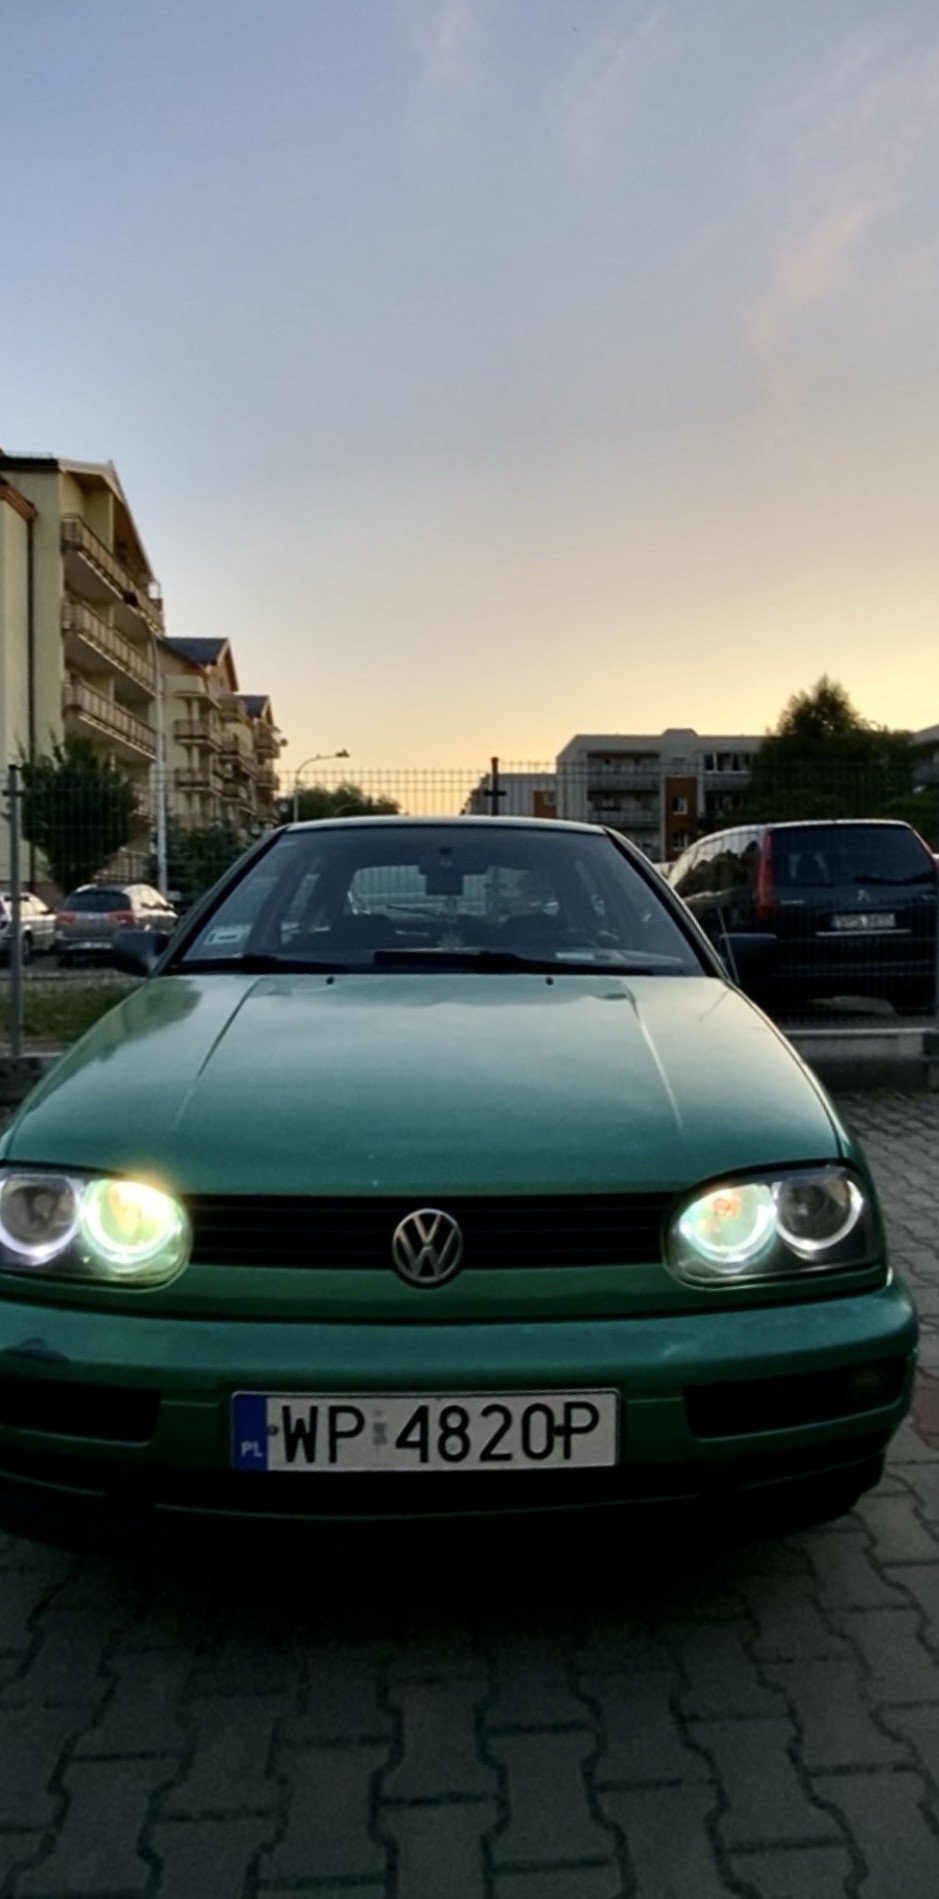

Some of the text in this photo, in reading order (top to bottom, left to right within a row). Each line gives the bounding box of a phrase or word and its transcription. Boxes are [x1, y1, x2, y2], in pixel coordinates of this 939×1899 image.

[240, 1441, 264, 1457] PL
[281, 1402, 599, 1463] WP 4820P
